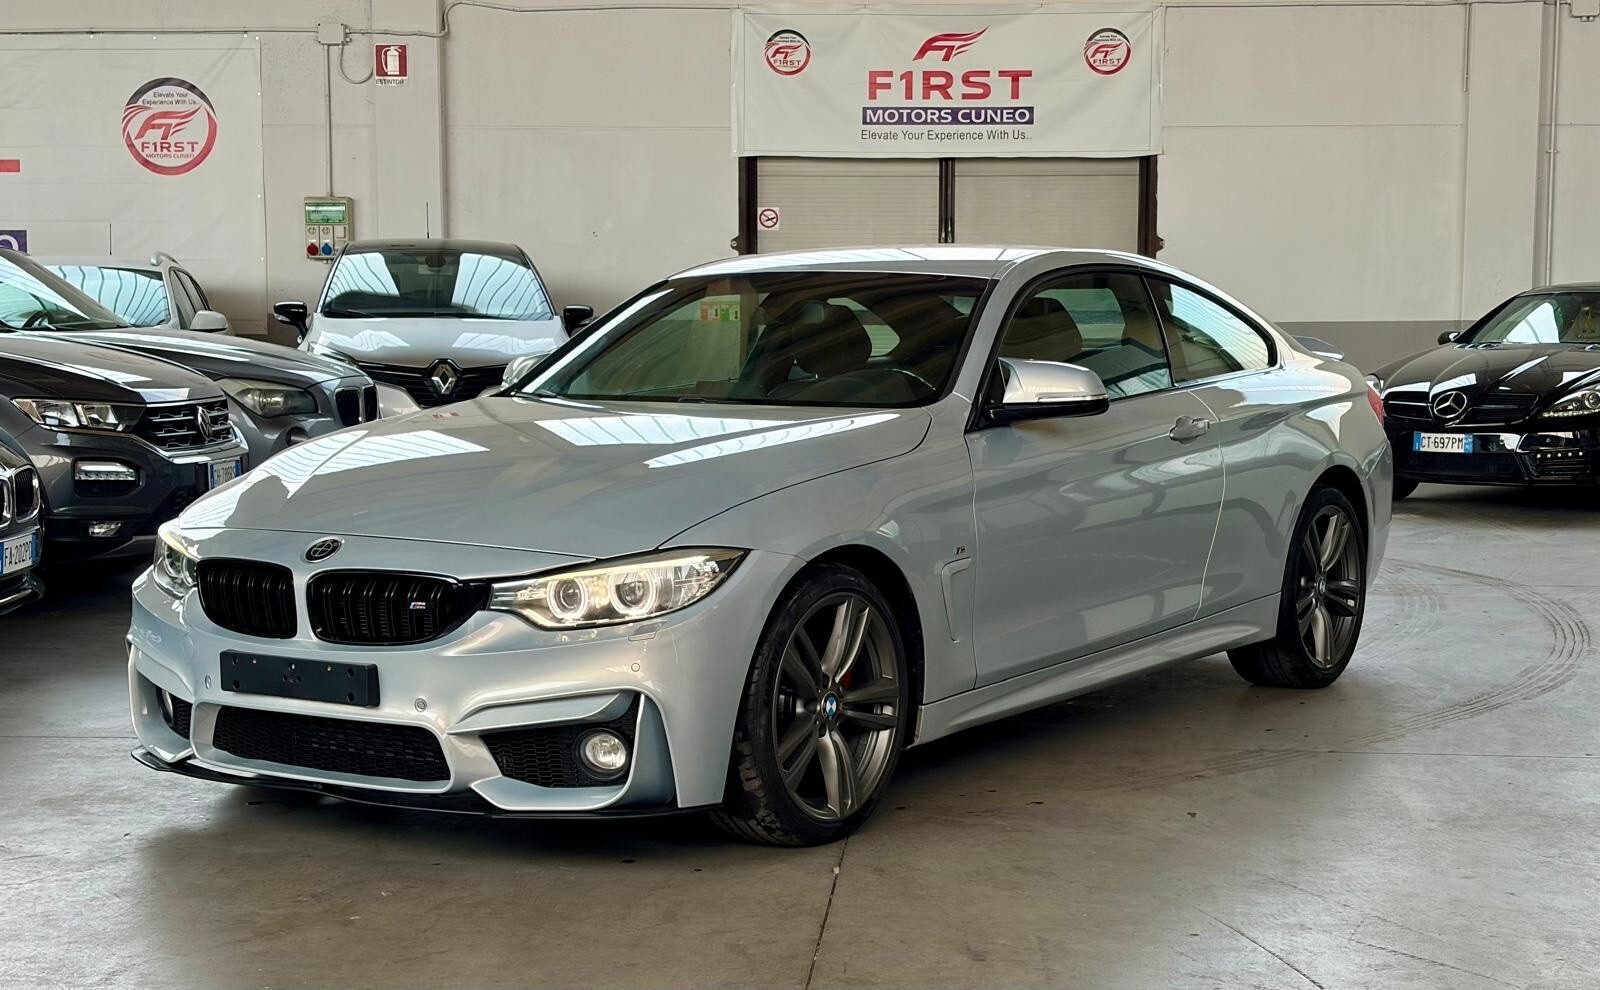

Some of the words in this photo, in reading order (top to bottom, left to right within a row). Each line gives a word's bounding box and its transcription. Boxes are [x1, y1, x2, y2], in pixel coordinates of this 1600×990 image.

[868, 70, 1033, 100] F1RST
[866, 109, 952, 123] MOTORS
[957, 108, 1030, 123] CUNEO
[861, 130, 898, 140] Elevate
[901, 130, 924, 140] Your
[928, 130, 983, 142] Experience
[986, 130, 1009, 140] With
[141, 142, 199, 152] F1RST
